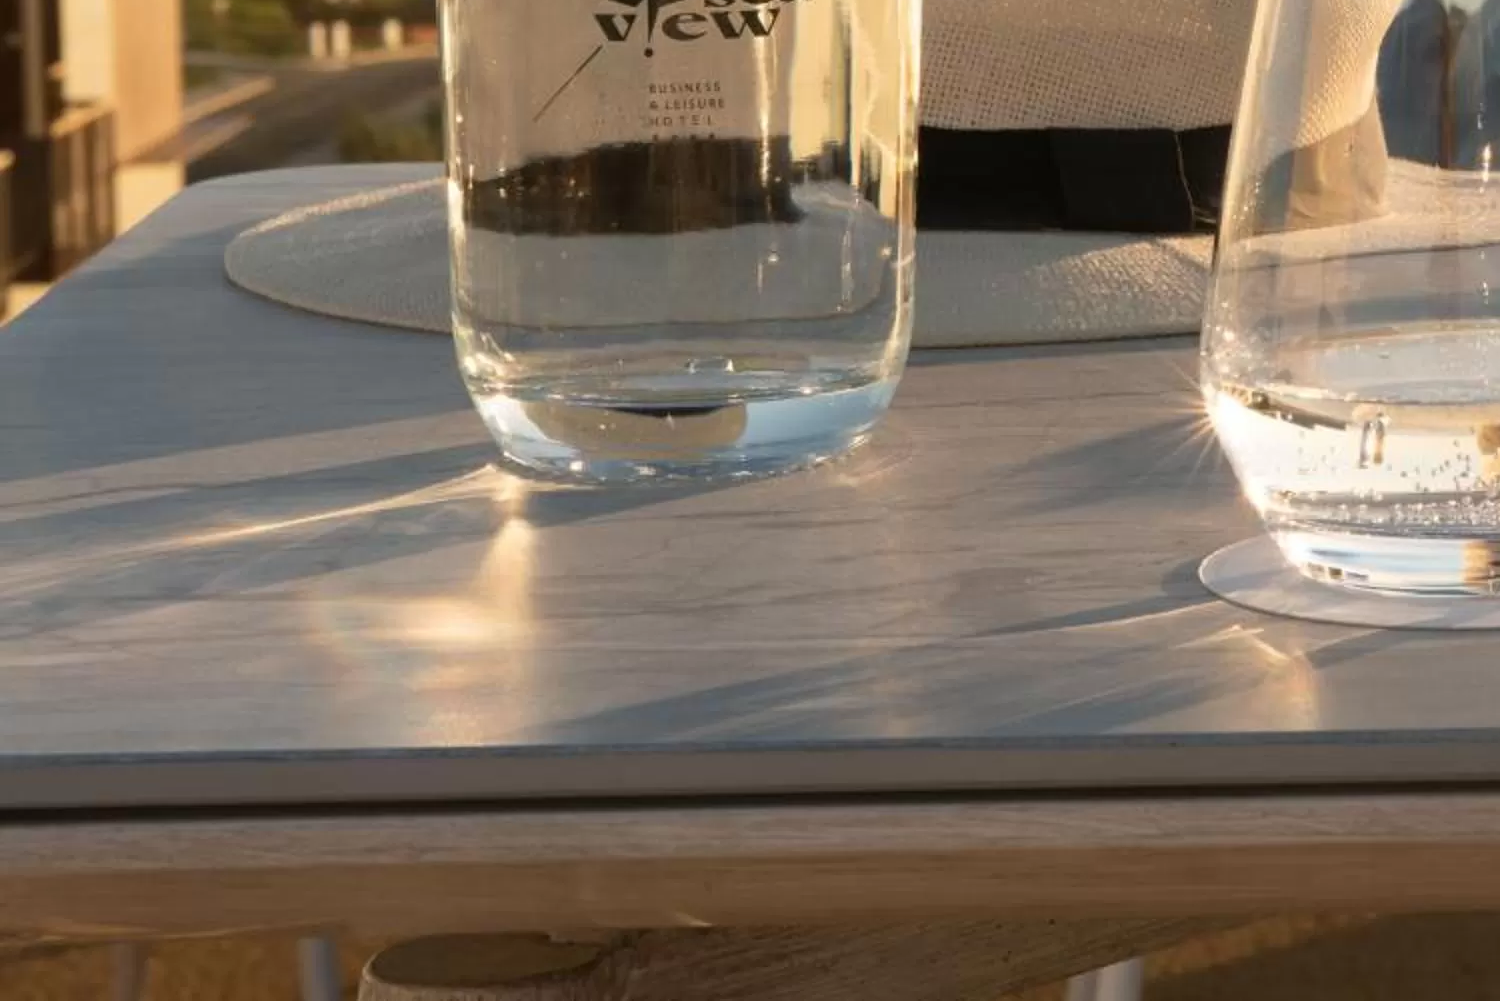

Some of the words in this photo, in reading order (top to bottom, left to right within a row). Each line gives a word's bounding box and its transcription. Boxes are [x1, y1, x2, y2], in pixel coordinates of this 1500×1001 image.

[594, 8, 781, 58] view
[649, 82, 721, 93] BUSINESS
[664, 98, 725, 110] LEISURE
